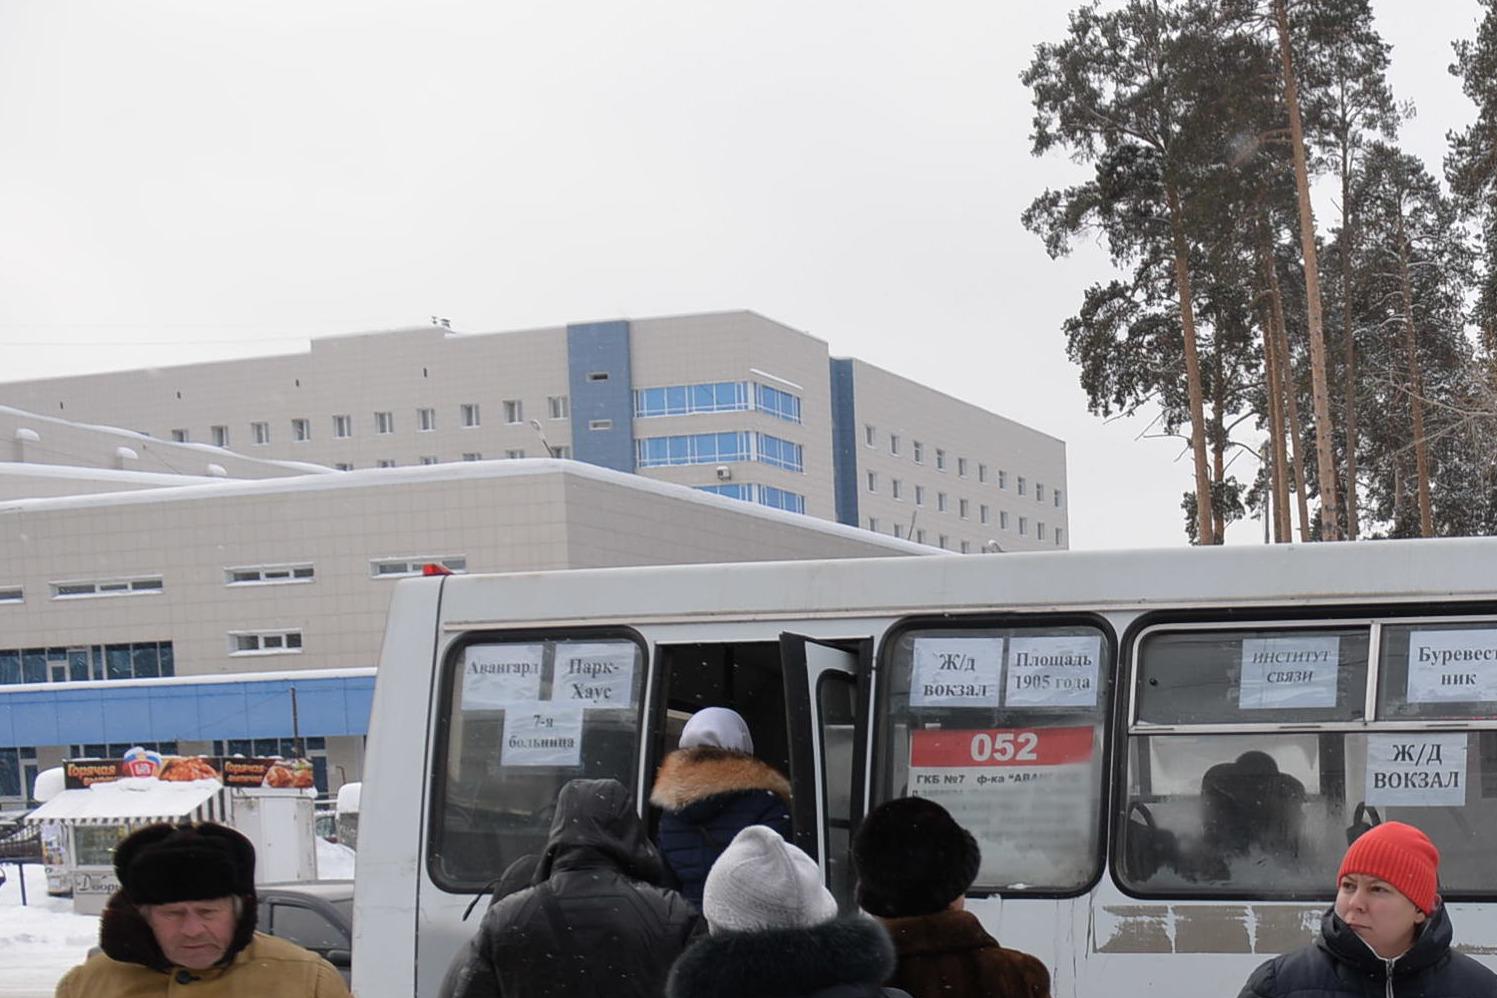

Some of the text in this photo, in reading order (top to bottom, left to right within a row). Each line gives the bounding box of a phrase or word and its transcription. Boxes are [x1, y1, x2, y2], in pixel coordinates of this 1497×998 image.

[939, 653, 976, 672] Ж/д
[1016, 652, 1092, 669] Площадь
[1252, 650, 1331, 664] ИНСТИТУТ
[467, 660, 540, 678] Авангард
[568, 658, 619, 678] Парк-
[1015, 674, 1091, 691] 1905 года
[1266, 670, 1314, 684] СВЯЗИ
[1440, 673, 1477, 686] ник
[571, 683, 613, 704] Хаус
[923, 683, 987, 698] вокзал
[533, 714, 554, 728] 7-я
[508, 733, 575, 749] больница
[970, 731, 1039, 762] 052
[1392, 743, 1443, 766] Ж/Д
[916, 773, 941, 785] ГКБ
[943, 773, 967, 785] №7
[976, 773, 1005, 787] ф-ка
[1373, 771, 1460, 789] ВОКЗАЛ
